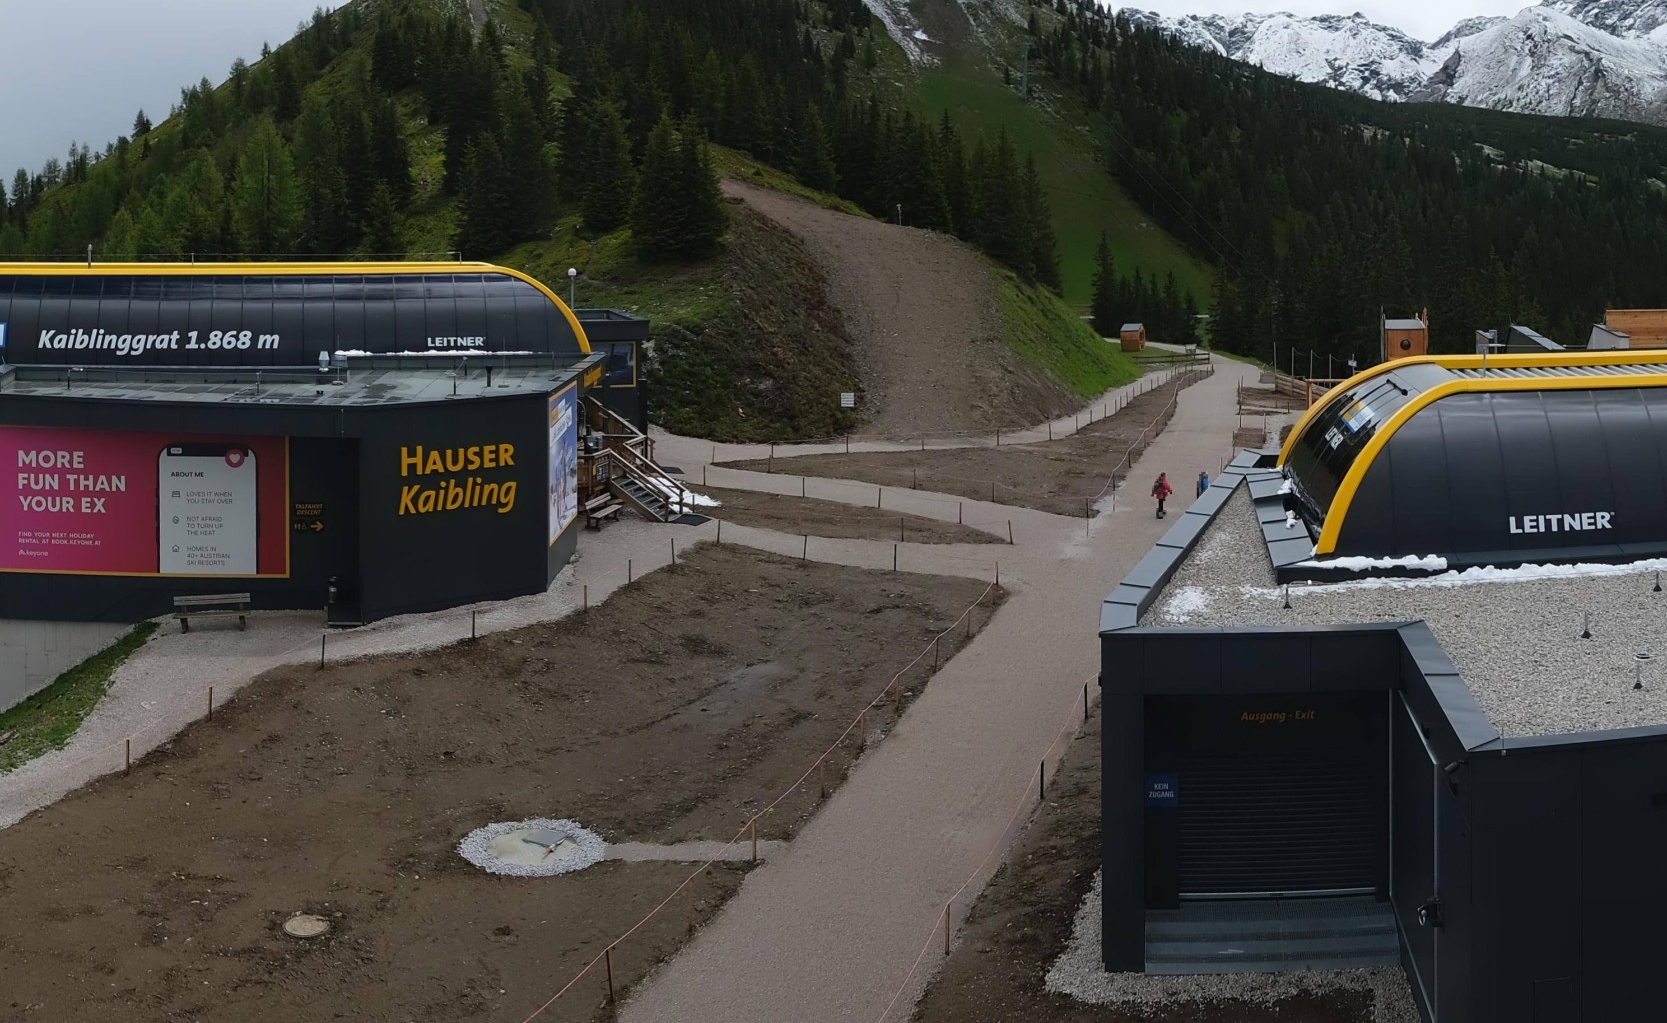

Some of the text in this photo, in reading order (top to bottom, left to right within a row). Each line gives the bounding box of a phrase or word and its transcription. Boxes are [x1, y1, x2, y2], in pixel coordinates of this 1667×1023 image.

[38, 329, 279, 355] Kaiblinggrat 1.868 m
[427, 336, 484, 347] LEITNER
[18, 450, 84, 468] MORE
[401, 444, 515, 476] HAUSER
[18, 473, 126, 491] FUN THAN
[19, 496, 106, 513] YOUR EX
[399, 476, 517, 515] Kaibling
[1509, 512, 1612, 534] LEITNER
[1241, 711, 1286, 723] Ausgang
[1295, 710, 1314, 720] Exit
